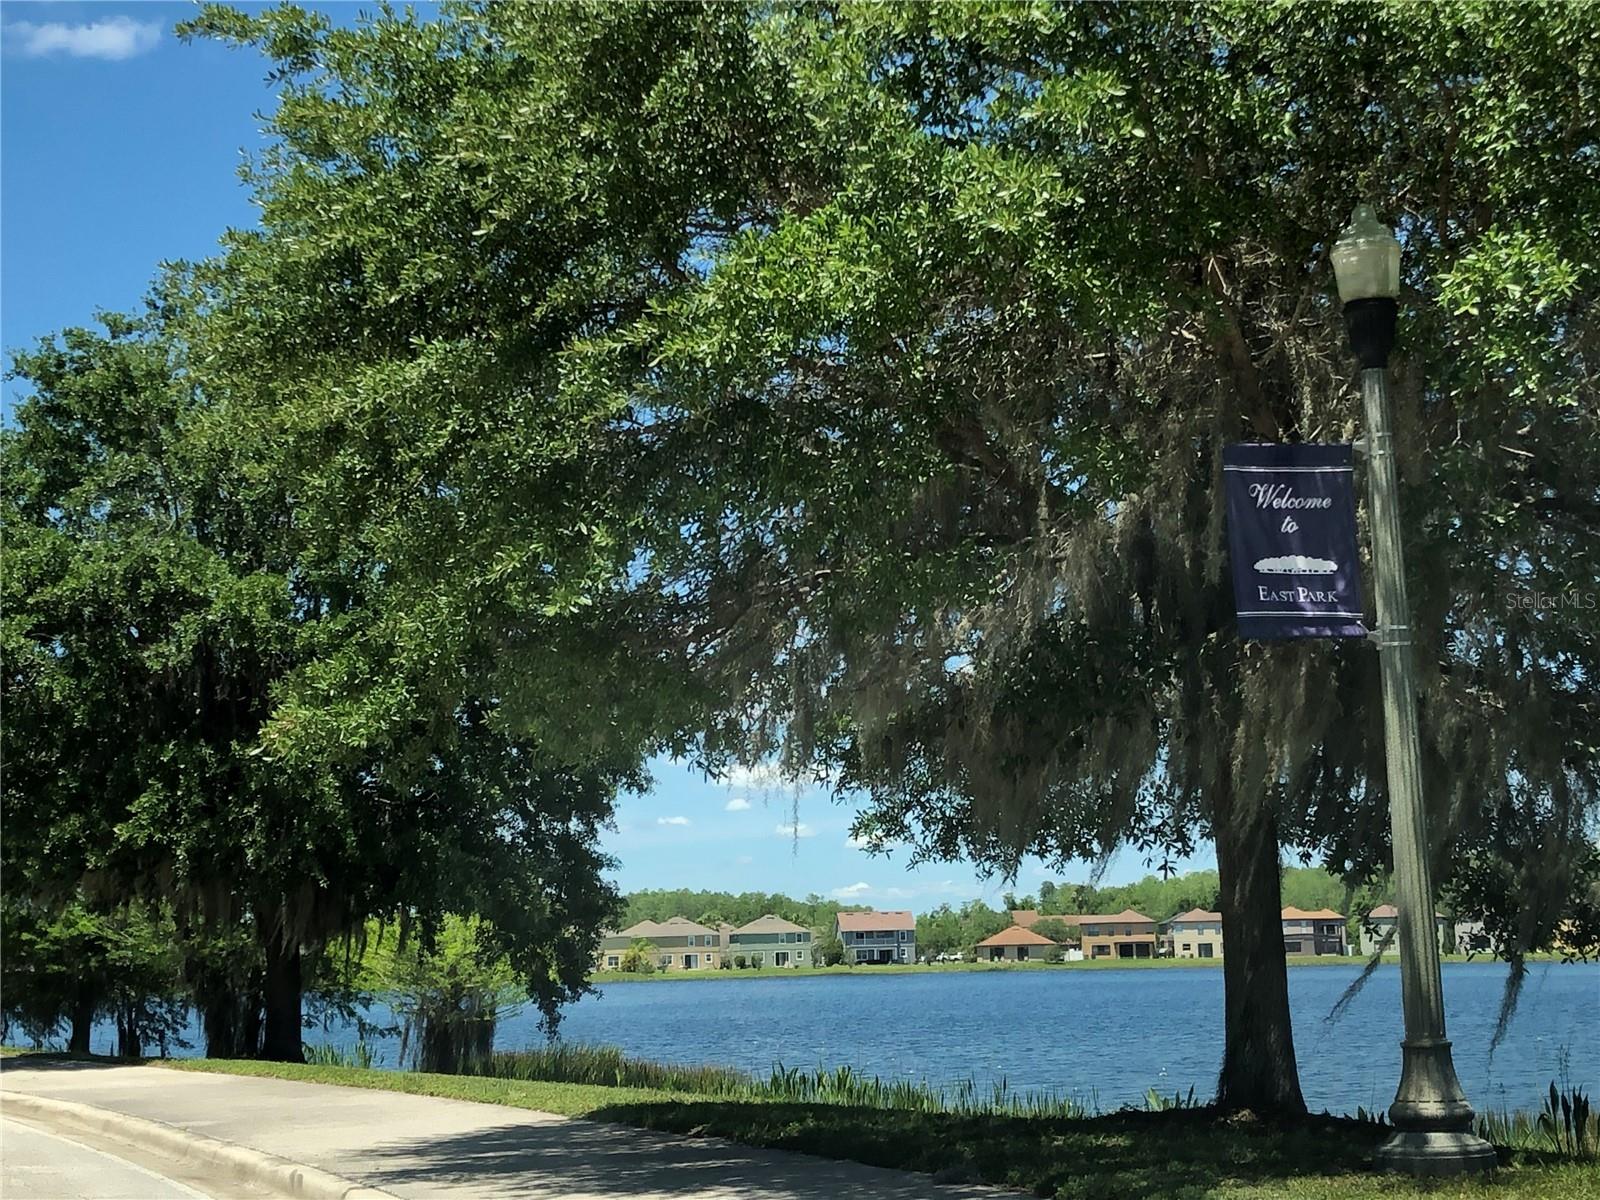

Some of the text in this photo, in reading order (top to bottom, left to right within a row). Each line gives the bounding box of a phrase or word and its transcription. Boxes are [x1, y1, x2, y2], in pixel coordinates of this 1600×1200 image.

[1249, 483, 1332, 509] Welcome
[1281, 515, 1299, 533] to
[1258, 585, 1338, 603] EAST PARK
